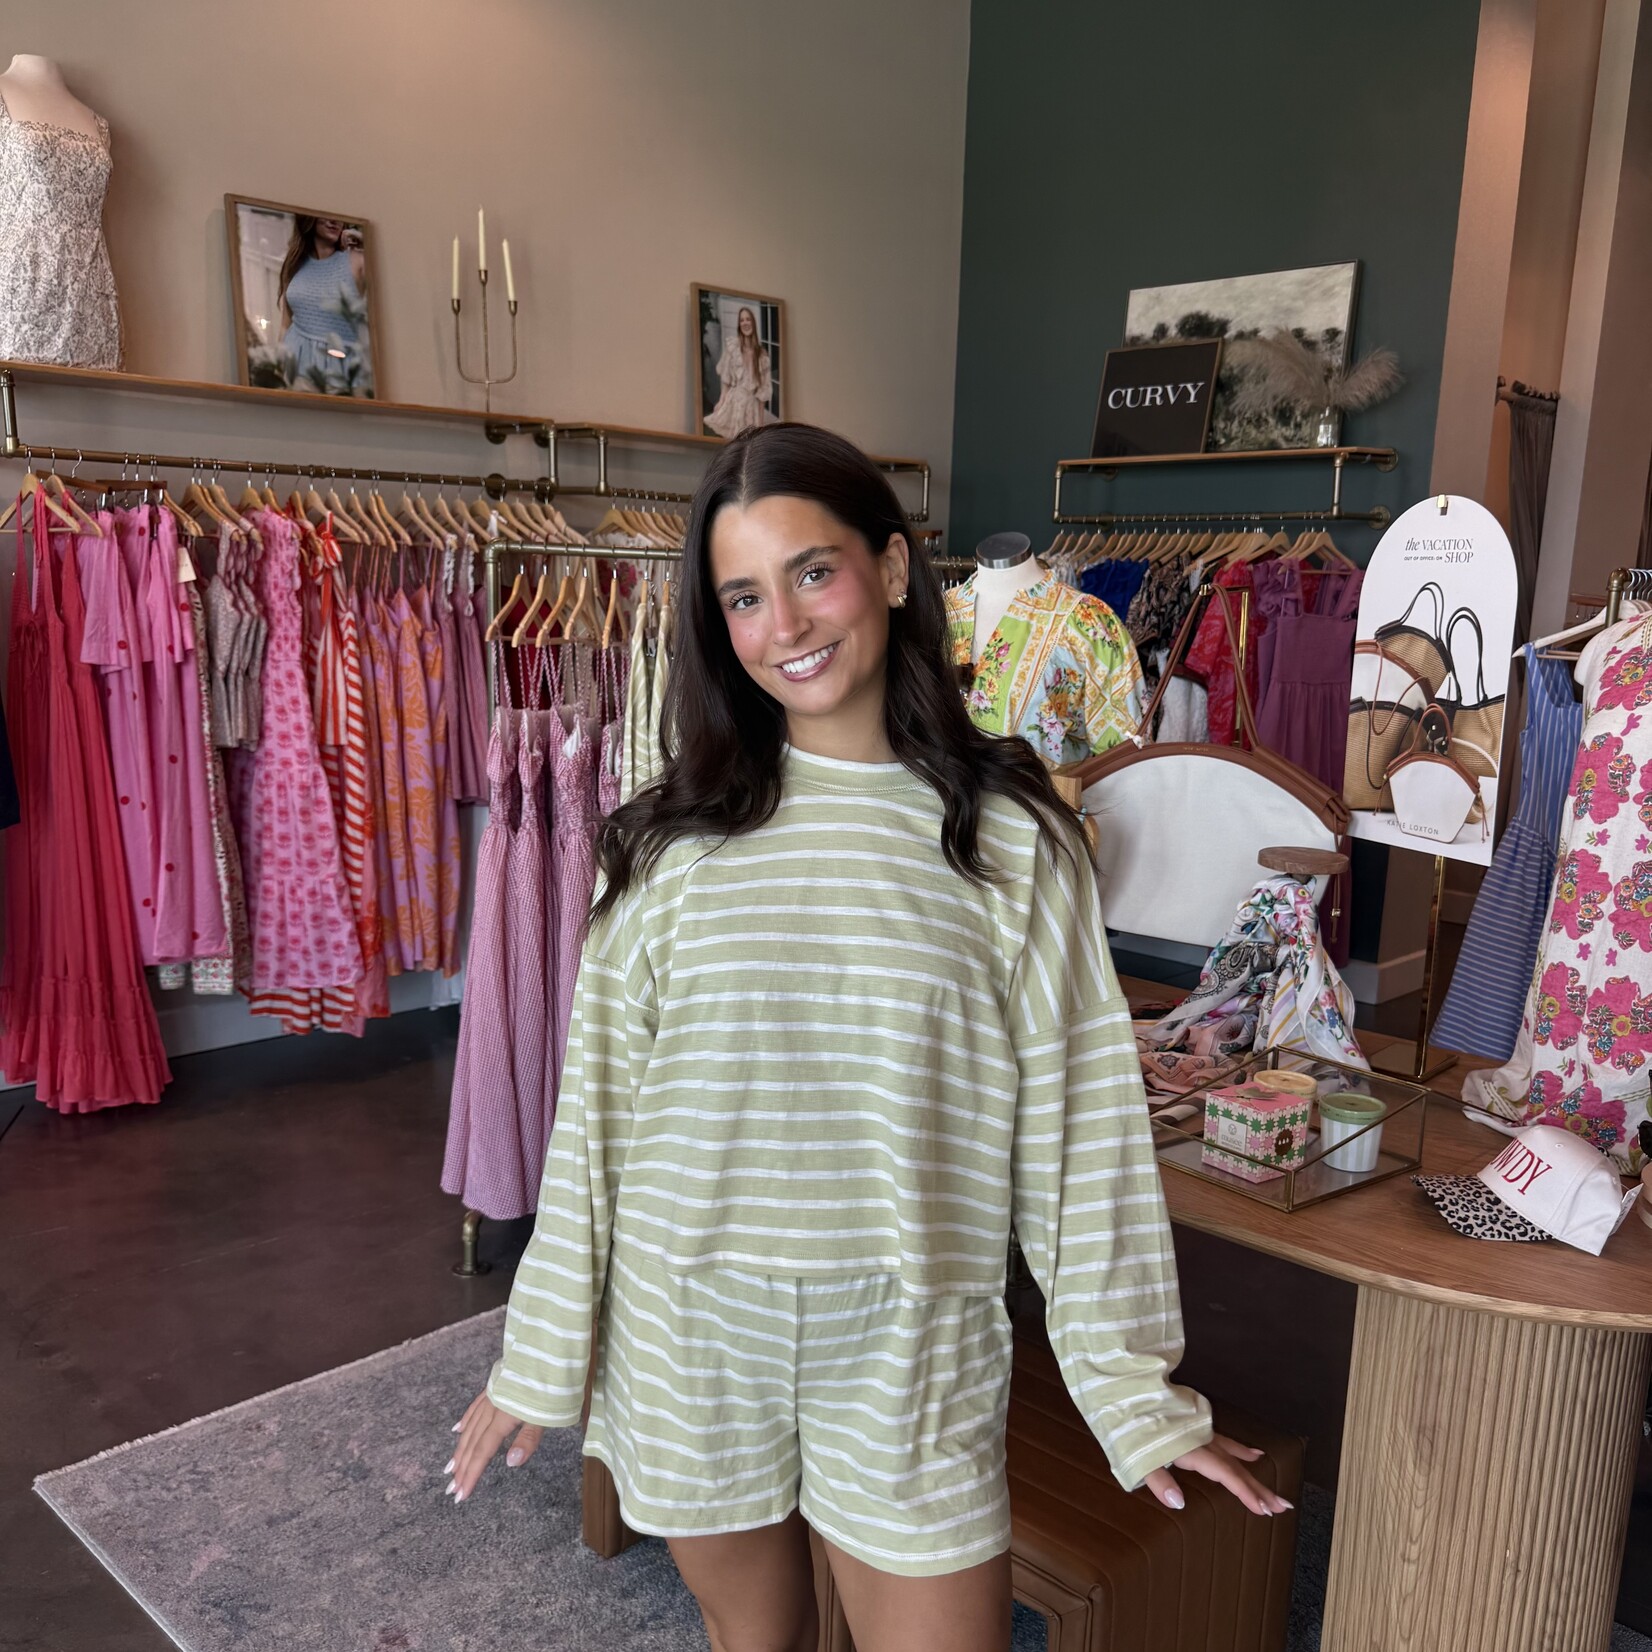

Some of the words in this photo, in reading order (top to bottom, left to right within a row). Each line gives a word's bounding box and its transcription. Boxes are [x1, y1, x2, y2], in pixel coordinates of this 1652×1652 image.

[1108, 382, 1205, 410] CURVY
[1405, 537, 1420, 551] the
[1422, 538, 1473, 551] VACATION
[1444, 551, 1474, 563] SHOP
[1409, 823, 1439, 835] LOXTON
